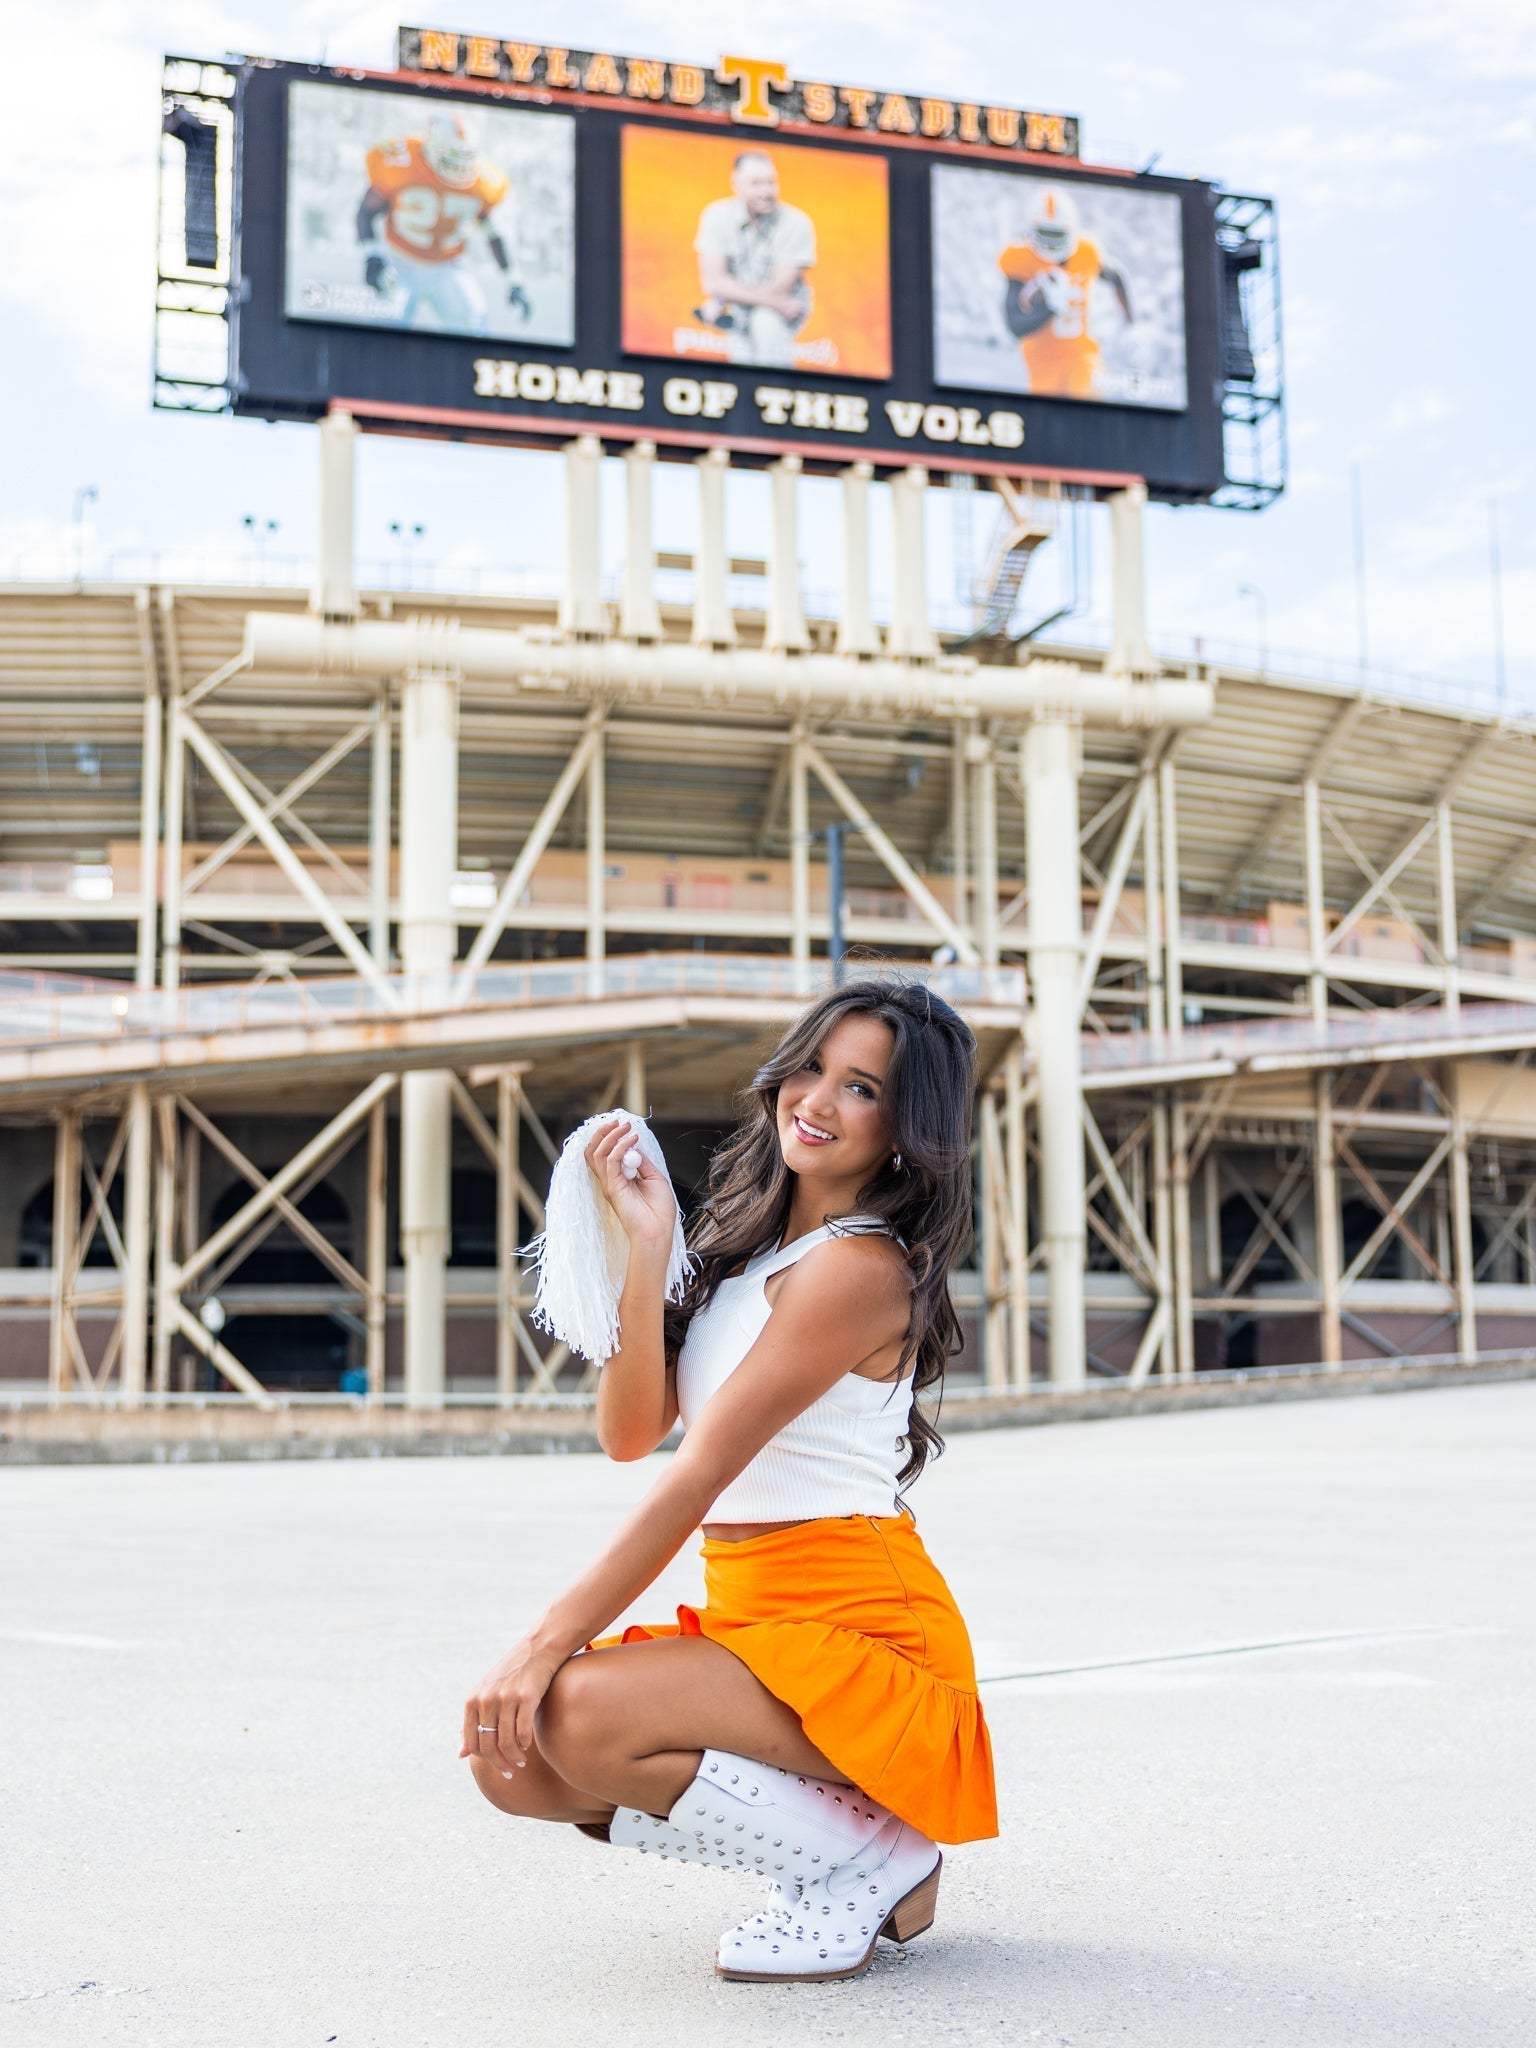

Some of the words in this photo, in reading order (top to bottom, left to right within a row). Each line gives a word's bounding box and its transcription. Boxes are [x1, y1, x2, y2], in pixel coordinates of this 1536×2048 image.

[419, 29, 705, 105] NEYLAND
[715, 55, 792, 127] T
[803, 83, 1067, 152] STADIUM
[391, 185, 484, 249] 27
[473, 358, 644, 411] HOME
[663, 377, 738, 419] OF
[755, 386, 869, 433] THE
[884, 400, 1025, 448] VOLS
